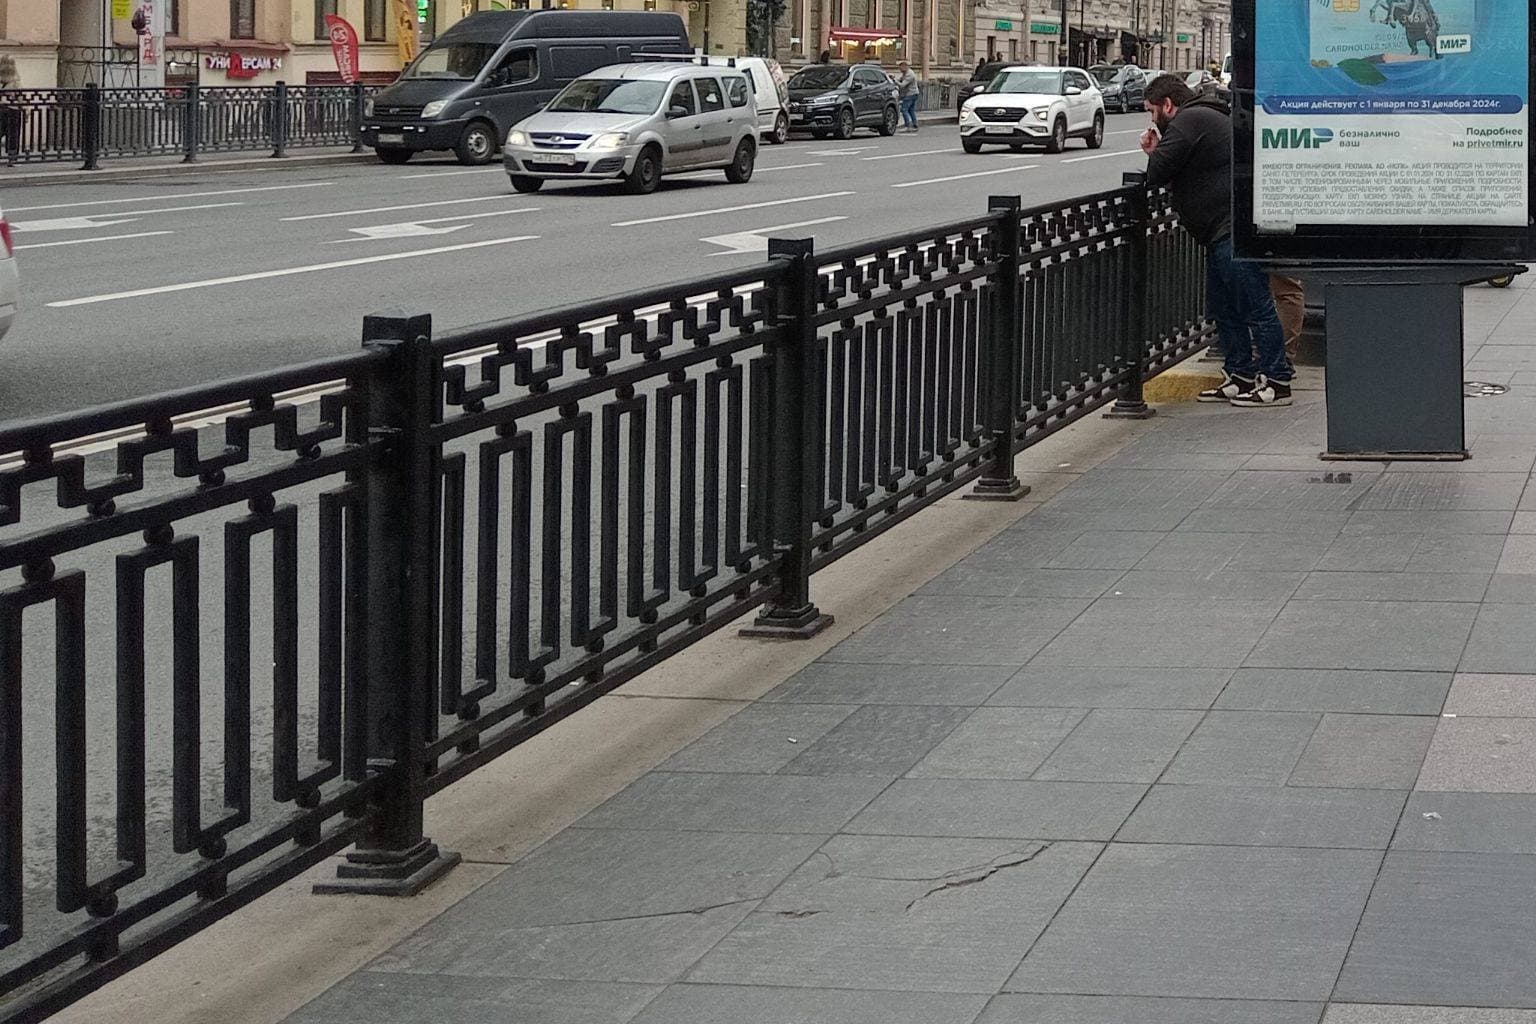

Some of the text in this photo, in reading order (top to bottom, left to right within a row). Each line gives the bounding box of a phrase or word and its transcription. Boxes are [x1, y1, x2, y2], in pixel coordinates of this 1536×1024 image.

[1440, 39, 1468, 49] МИР
[272, 57, 282, 70] 24
[1280, 100, 1309, 109] Акция
[1310, 100, 1357, 109] действует
[1366, 100, 1370, 108] 1
[1373, 102, 1405, 110] января
[1421, 100, 1430, 108] 31
[1431, 99, 1470, 109] декабря
[1472, 100, 1501, 108] 2024г.
[1339, 129, 1400, 138] безналично
[1466, 127, 1523, 137] Подробнее
[1262, 128, 1334, 149] МИР
[1339, 140, 1360, 148] ваш
[1467, 140, 1523, 149] privetmir.ru
